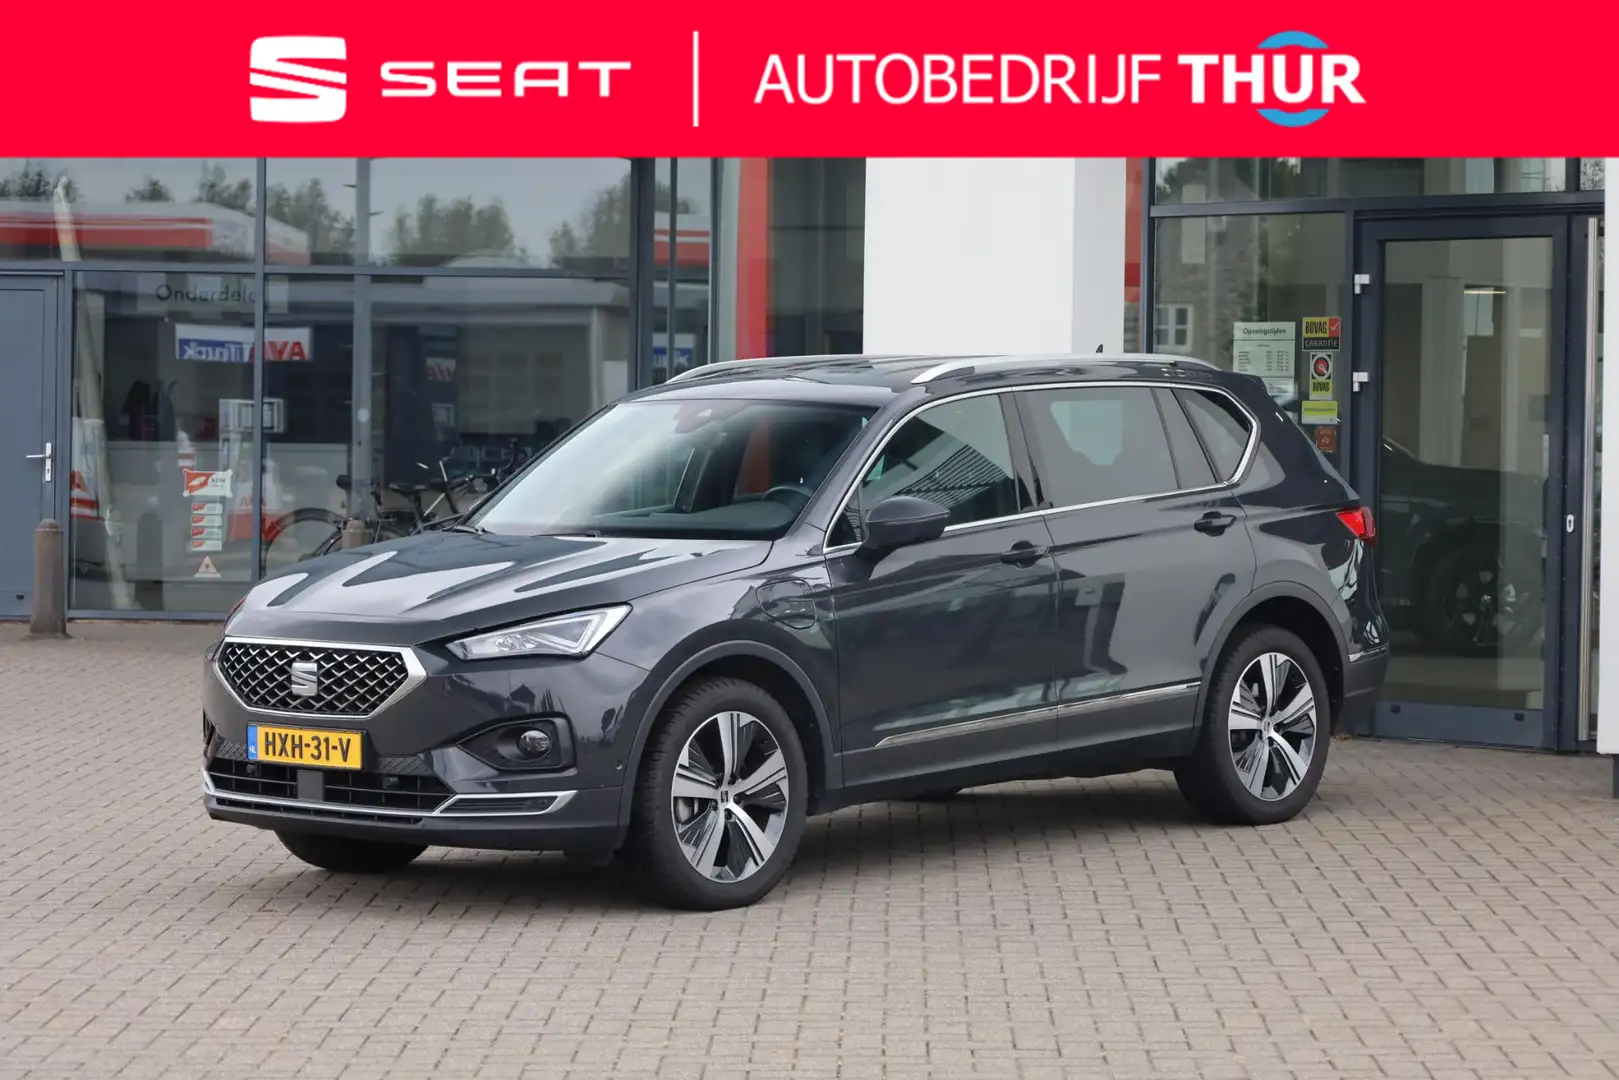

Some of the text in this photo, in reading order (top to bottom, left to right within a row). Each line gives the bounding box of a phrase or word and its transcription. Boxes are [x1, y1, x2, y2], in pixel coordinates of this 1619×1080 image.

[155, 283, 257, 302] Onderdele
[1242, 327, 1287, 336] Openingstijden
[1305, 320, 1328, 336] BOVAG
[1304, 339, 1338, 348] GARANTIE
[1312, 380, 1330, 392] BOVAG
[249, 731, 351, 763] NL HXH-31-V
